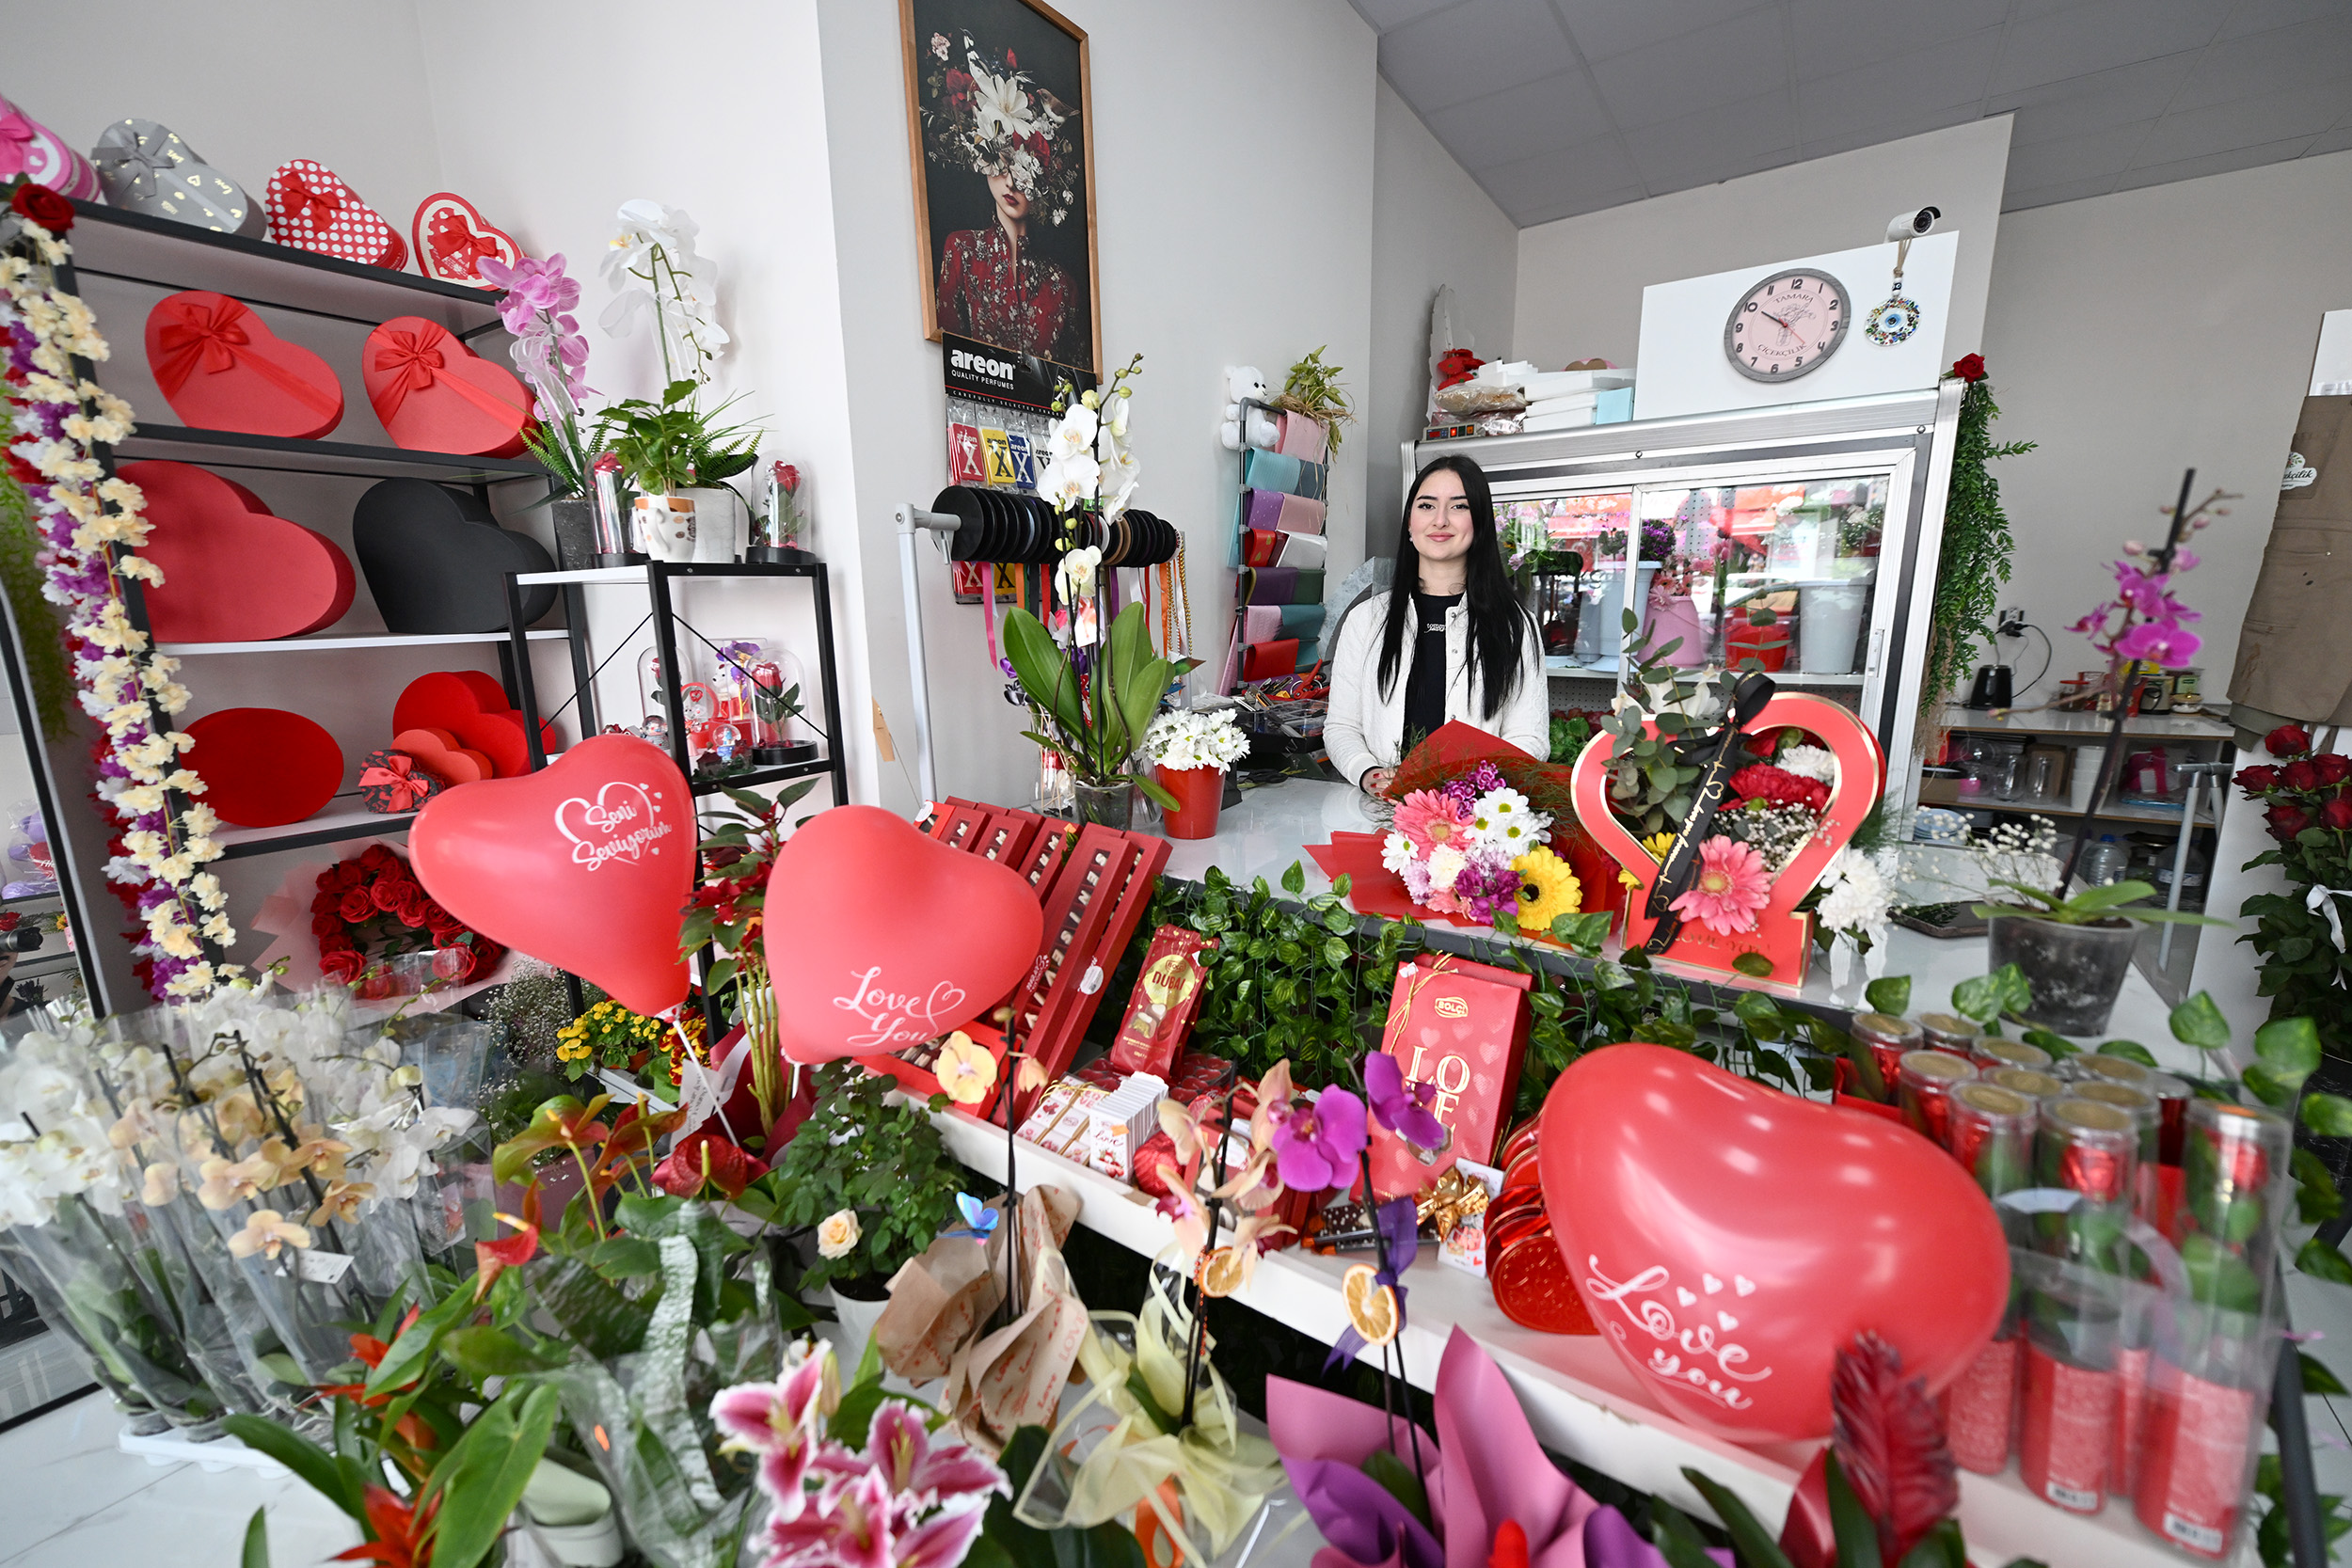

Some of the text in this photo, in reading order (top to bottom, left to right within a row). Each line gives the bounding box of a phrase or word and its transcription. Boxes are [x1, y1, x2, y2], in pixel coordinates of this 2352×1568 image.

[1767, 284, 1775, 296] 11
[1791, 278, 1804, 290] 12
[1818, 282, 1824, 294] 1
[1772, 293, 1814, 304] TAMARA
[1829, 299, 1839, 310] 2
[1743, 302, 1758, 313] 10
[1735, 323, 1744, 333] 9
[1830, 321, 1839, 331] 3
[1736, 342, 1743, 353] 8
[1757, 343, 1807, 356] ÇİÇEKÇİLİK
[1817, 341, 1825, 352] 4
[950, 349, 1013, 381] areon
[1750, 356, 1758, 368] 7
[1770, 363, 1779, 373] 6
[1794, 356, 1803, 368] 5
[951, 369, 1015, 390] QUALITY PERFUMES
[952, 389, 996, 404] CAREFULLY
[1000, 400, 1035, 412] SELECTED
[988, 445, 1013, 478] X
[1011, 451, 1033, 483] X
[585, 800, 638, 833] Seni
[571, 821, 673, 872] Seviyorum
[1675, 931, 1720, 949] OVE
[1152, 971, 1186, 991] DUBAI
[833, 966, 922, 1019] Love
[847, 1012, 929, 1047] You
[1586, 1254, 1772, 1382] Love
